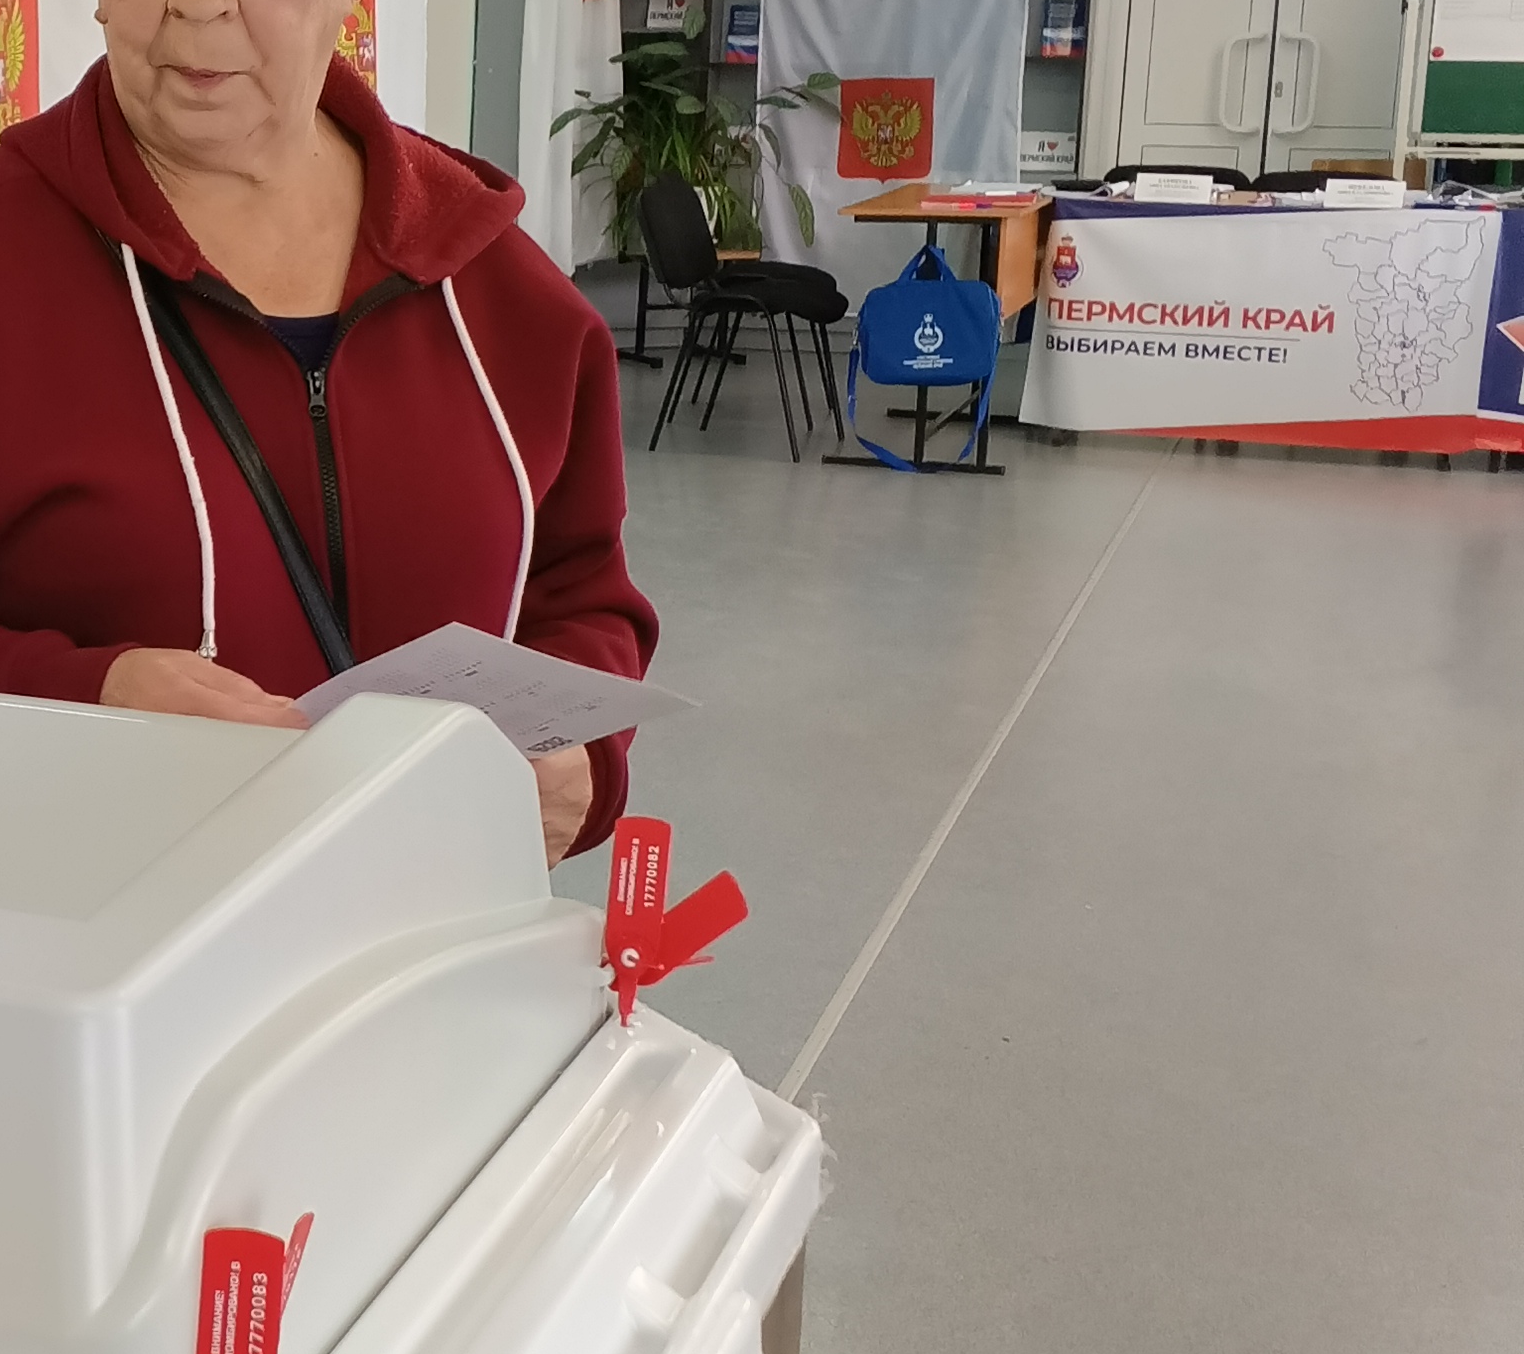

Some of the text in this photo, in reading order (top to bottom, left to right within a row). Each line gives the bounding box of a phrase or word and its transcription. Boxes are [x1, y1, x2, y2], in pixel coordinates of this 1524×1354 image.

[1047, 297, 1335, 334] ПЕРМСКИЙ КРАЙ
[1046, 334, 1288, 364] ВЫБИРАЕМ ВМЕСТЕ!
[644, 845, 660, 908] 17770082
